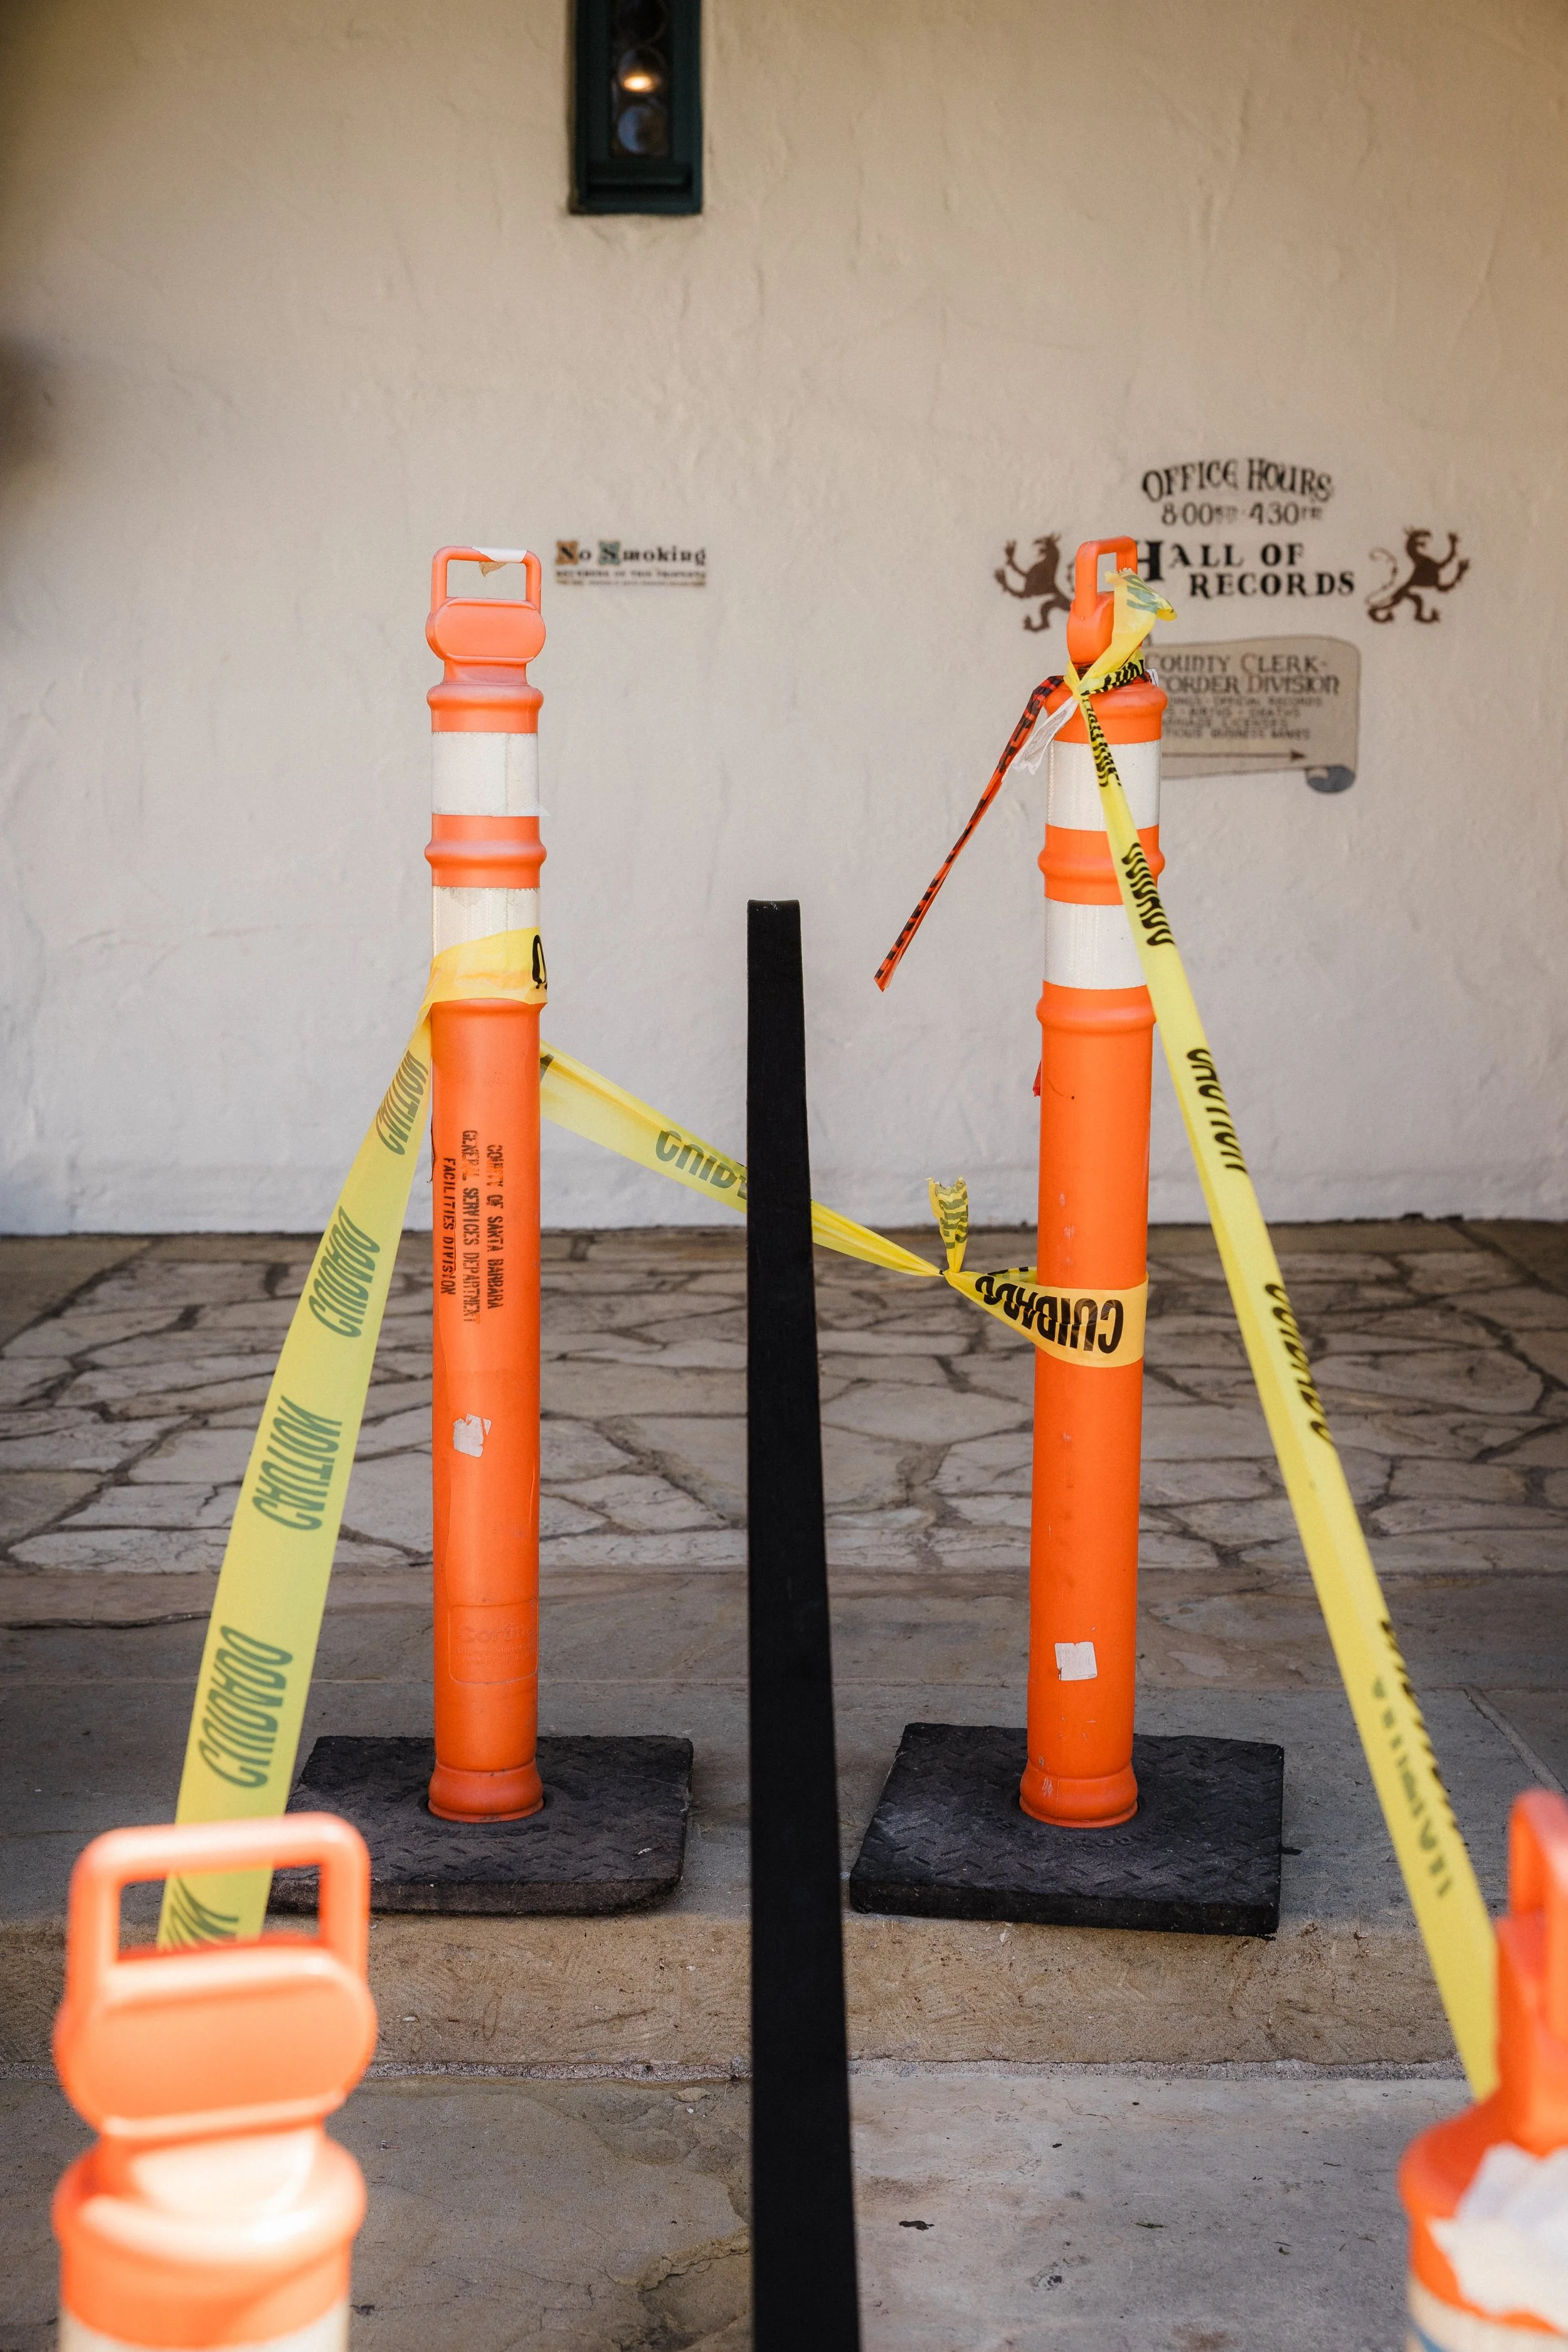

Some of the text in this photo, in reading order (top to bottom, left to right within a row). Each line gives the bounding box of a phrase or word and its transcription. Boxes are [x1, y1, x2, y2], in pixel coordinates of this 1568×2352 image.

[1142, 457, 1334, 503] OFFICE HOURS
[558, 542, 706, 566] No Smoking
[1136, 539, 1305, 582] HALL OF
[1190, 570, 1355, 599] RECORDS
[1144, 653, 1231, 674] COUNTY
[1247, 673, 1340, 695] DIVISION
[462, 1187, 480, 1246] SERVICES
[486, 1194, 504, 1209] OF
[440, 1158, 456, 1295] FACILITIES DIVISION
[487, 1216, 504, 1253] SANTA
[487, 1258, 504, 1310] BARBARA
